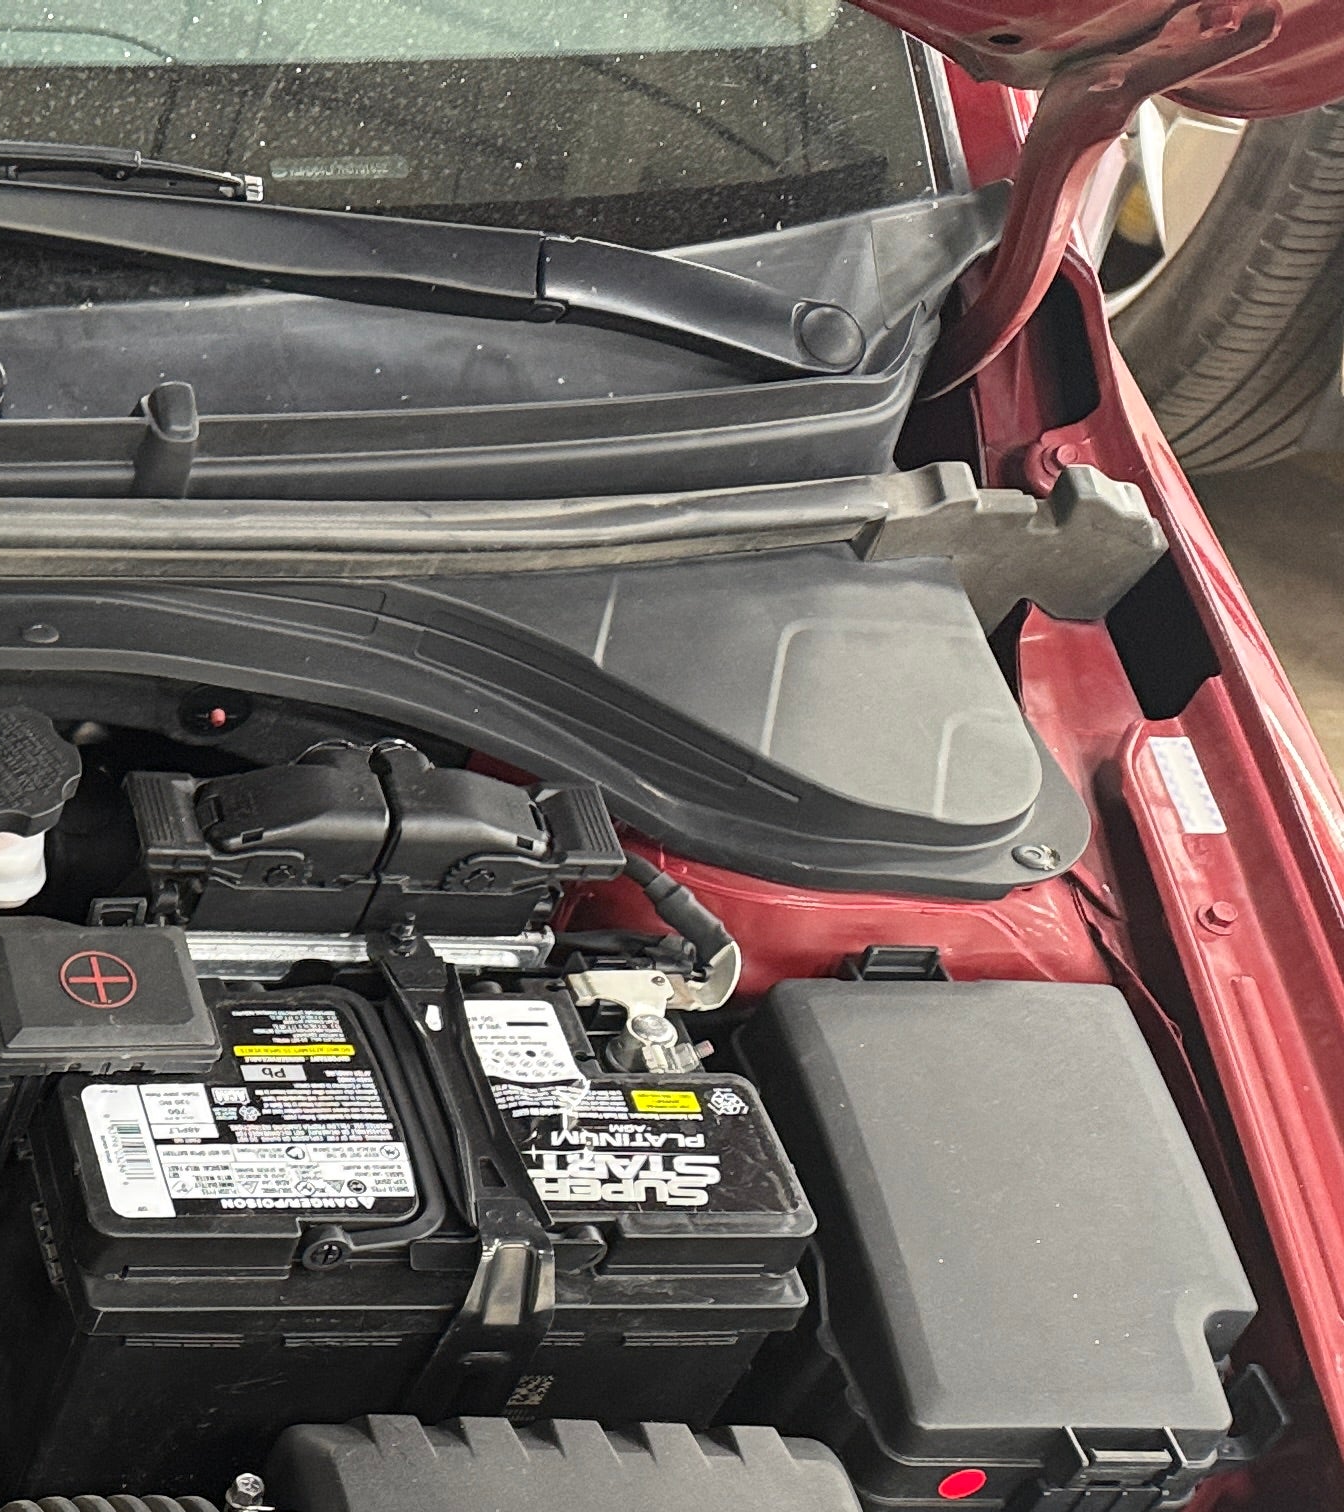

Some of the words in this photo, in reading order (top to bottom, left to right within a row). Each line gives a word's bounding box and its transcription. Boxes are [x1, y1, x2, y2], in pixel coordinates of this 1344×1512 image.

[261, 1066, 286, 1078] Pb
[609, 1123, 647, 1133] AGM
[550, 1129, 705, 1148] PLATINUM
[527, 1154, 722, 1185] START
[534, 1178, 710, 1206] SUPER
[221, 1197, 357, 1209] DANGER/POISON
